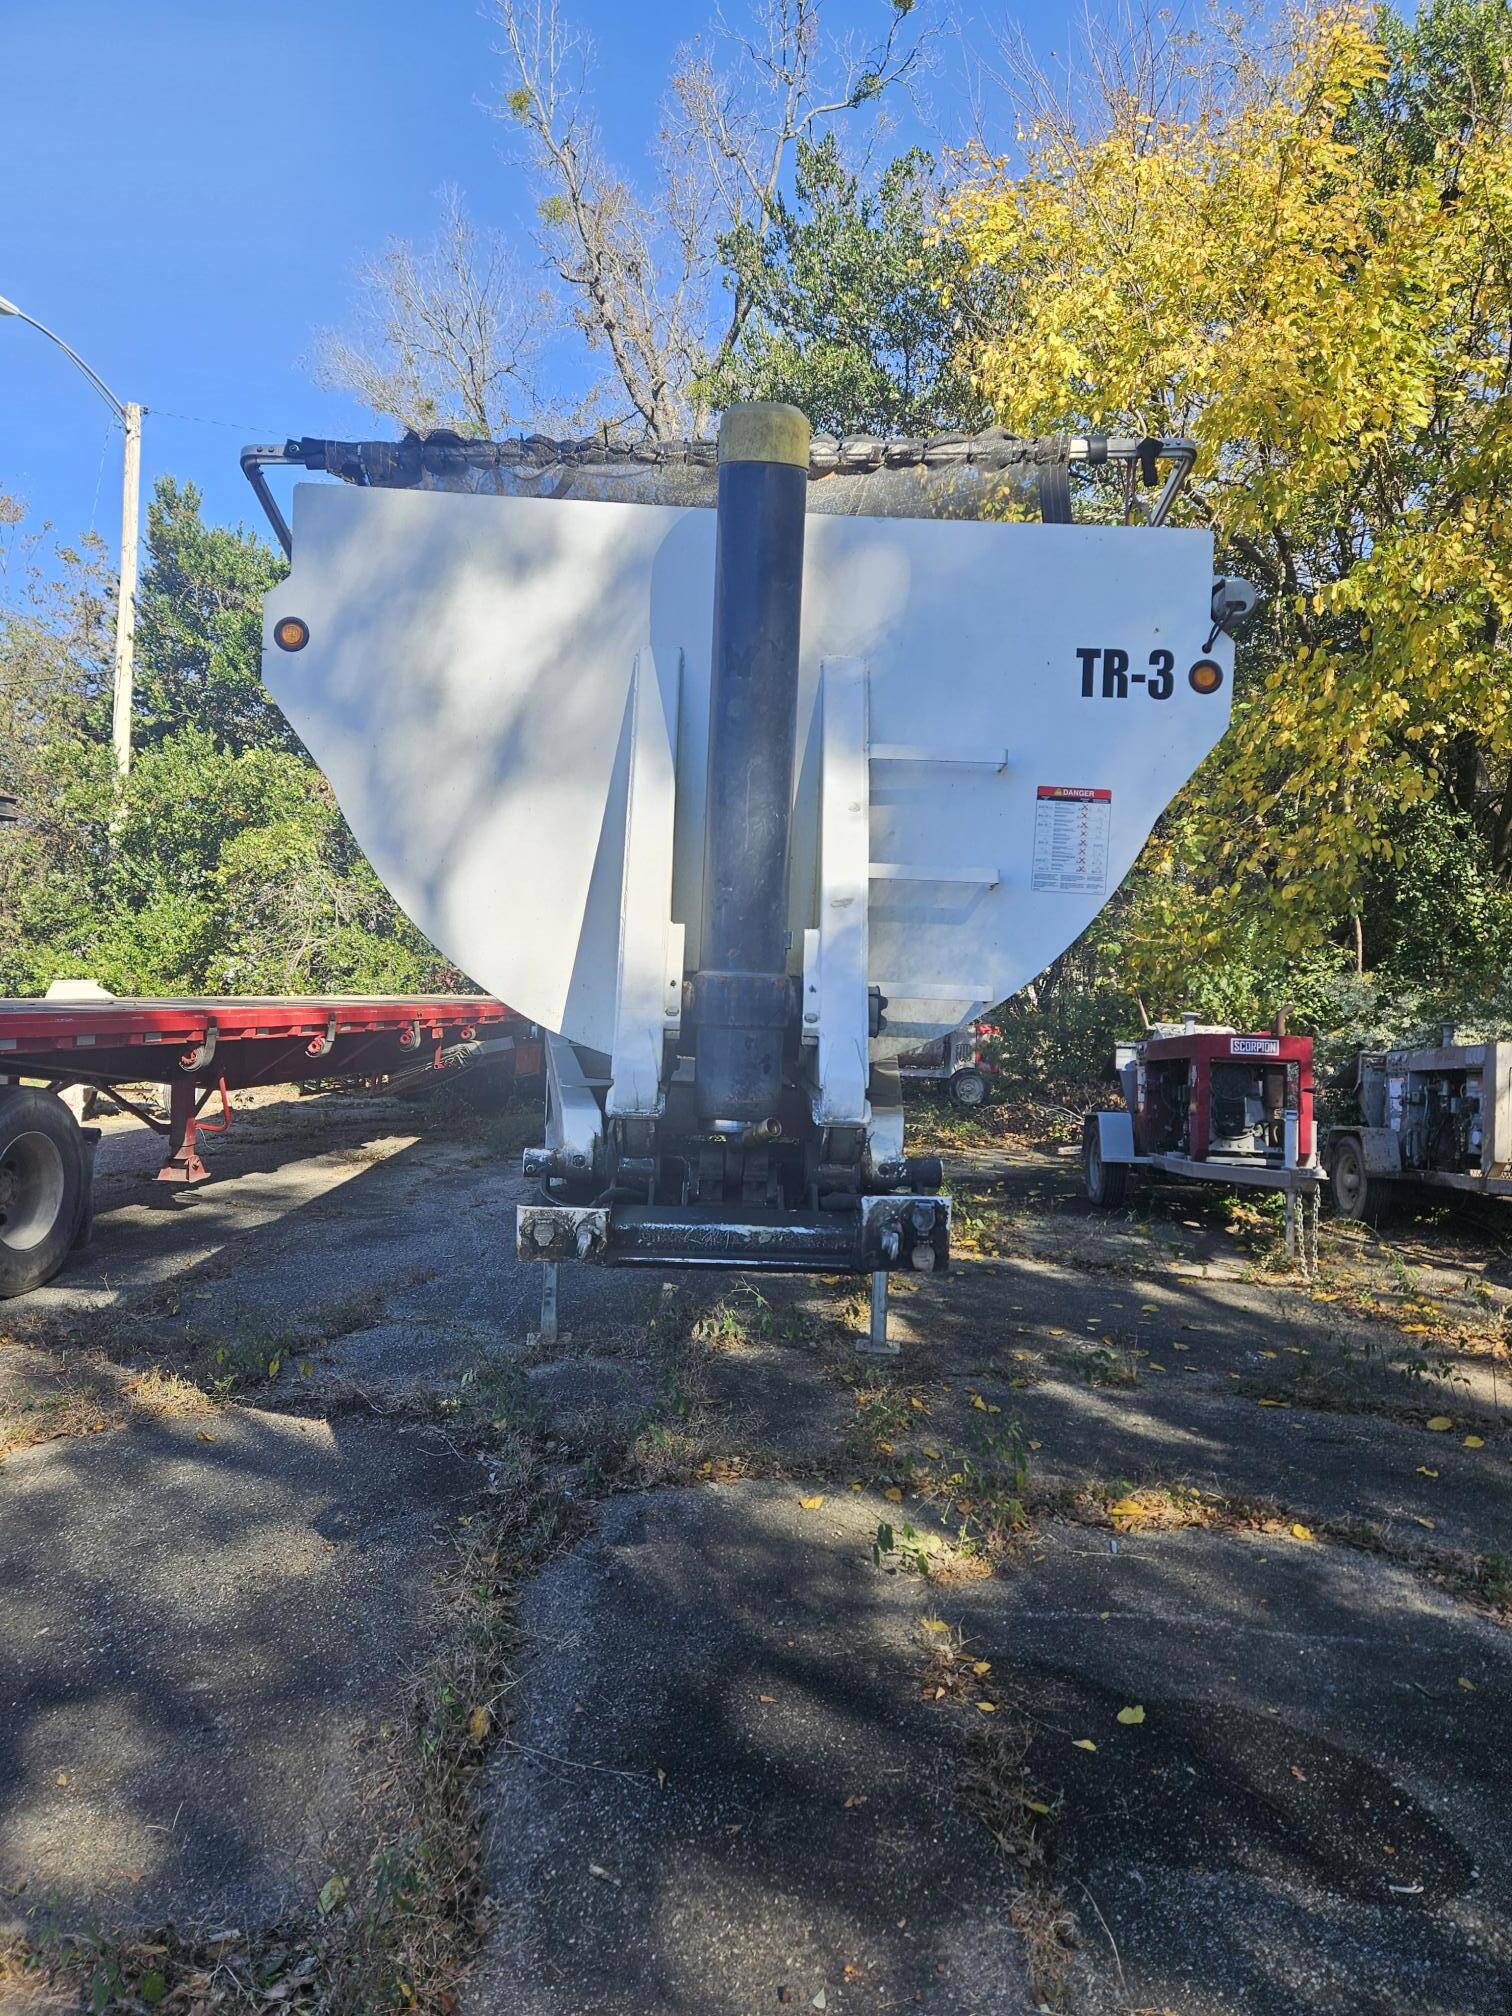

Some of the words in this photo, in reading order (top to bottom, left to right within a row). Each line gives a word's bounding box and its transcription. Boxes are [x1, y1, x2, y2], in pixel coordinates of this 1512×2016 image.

[1076, 648, 1174, 700] TR-3
[1063, 789, 1095, 797] DANGER
[1233, 1040, 1276, 1053] SCORPION
